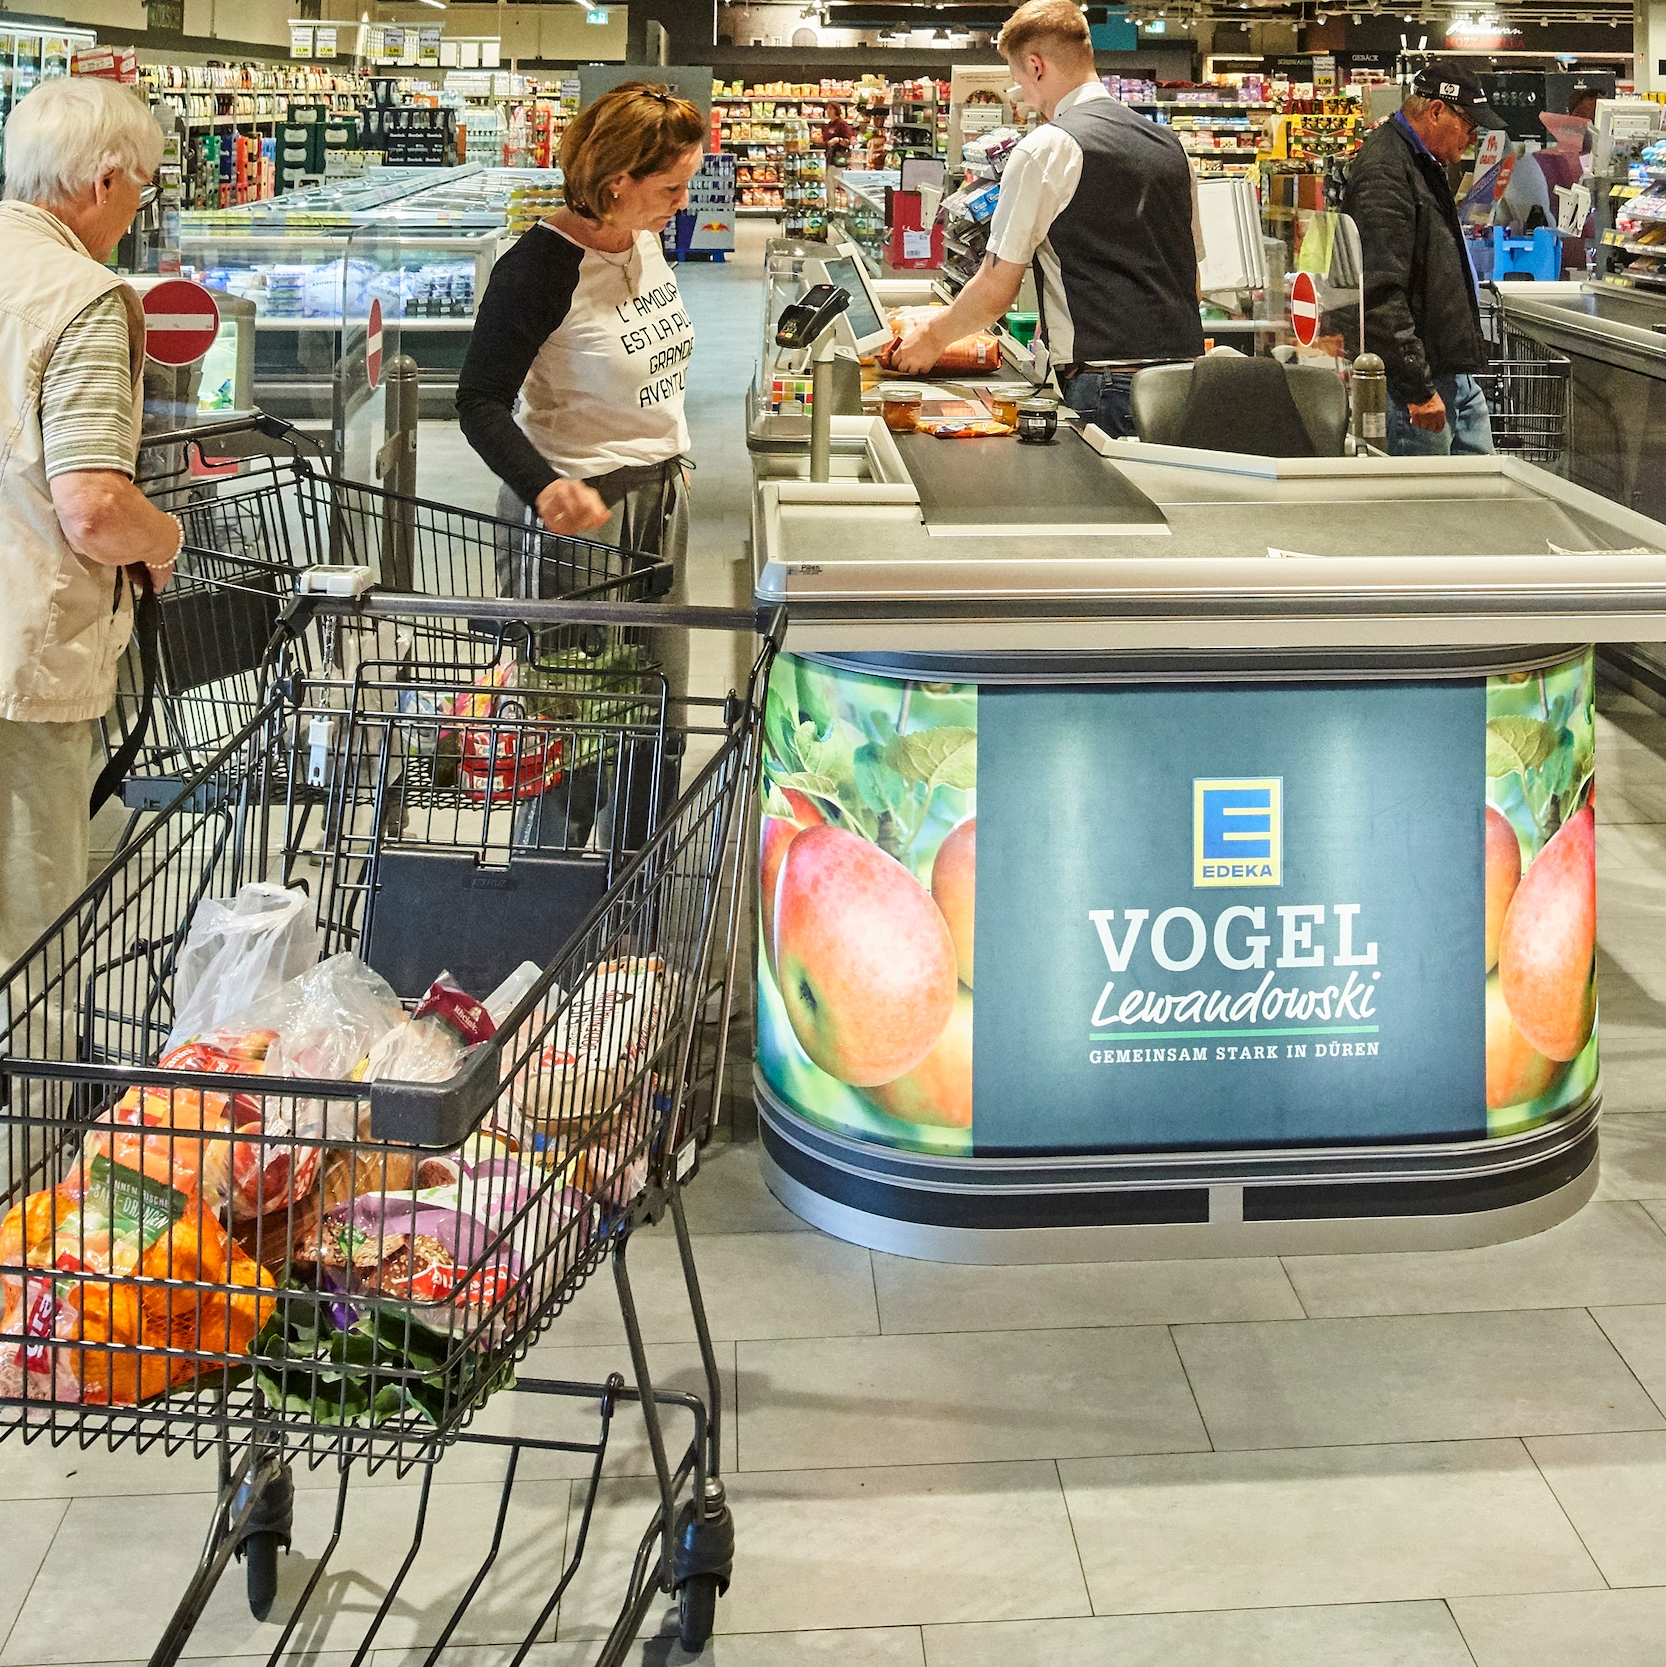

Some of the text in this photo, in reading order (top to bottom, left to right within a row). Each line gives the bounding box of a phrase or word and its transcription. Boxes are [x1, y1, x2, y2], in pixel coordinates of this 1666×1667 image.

[1351, 53, 1380, 63] GEBÄCK
[620, 326, 653, 355] EST
[654, 318, 675, 341] LA
[1202, 864, 1273, 879] EDEKA
[1088, 903, 1379, 973] VOGEL
[1089, 970, 1382, 1027] Lewandowski
[1089, 1040, 1380, 1064] GEMEINSAM STARK IN DÜREN
